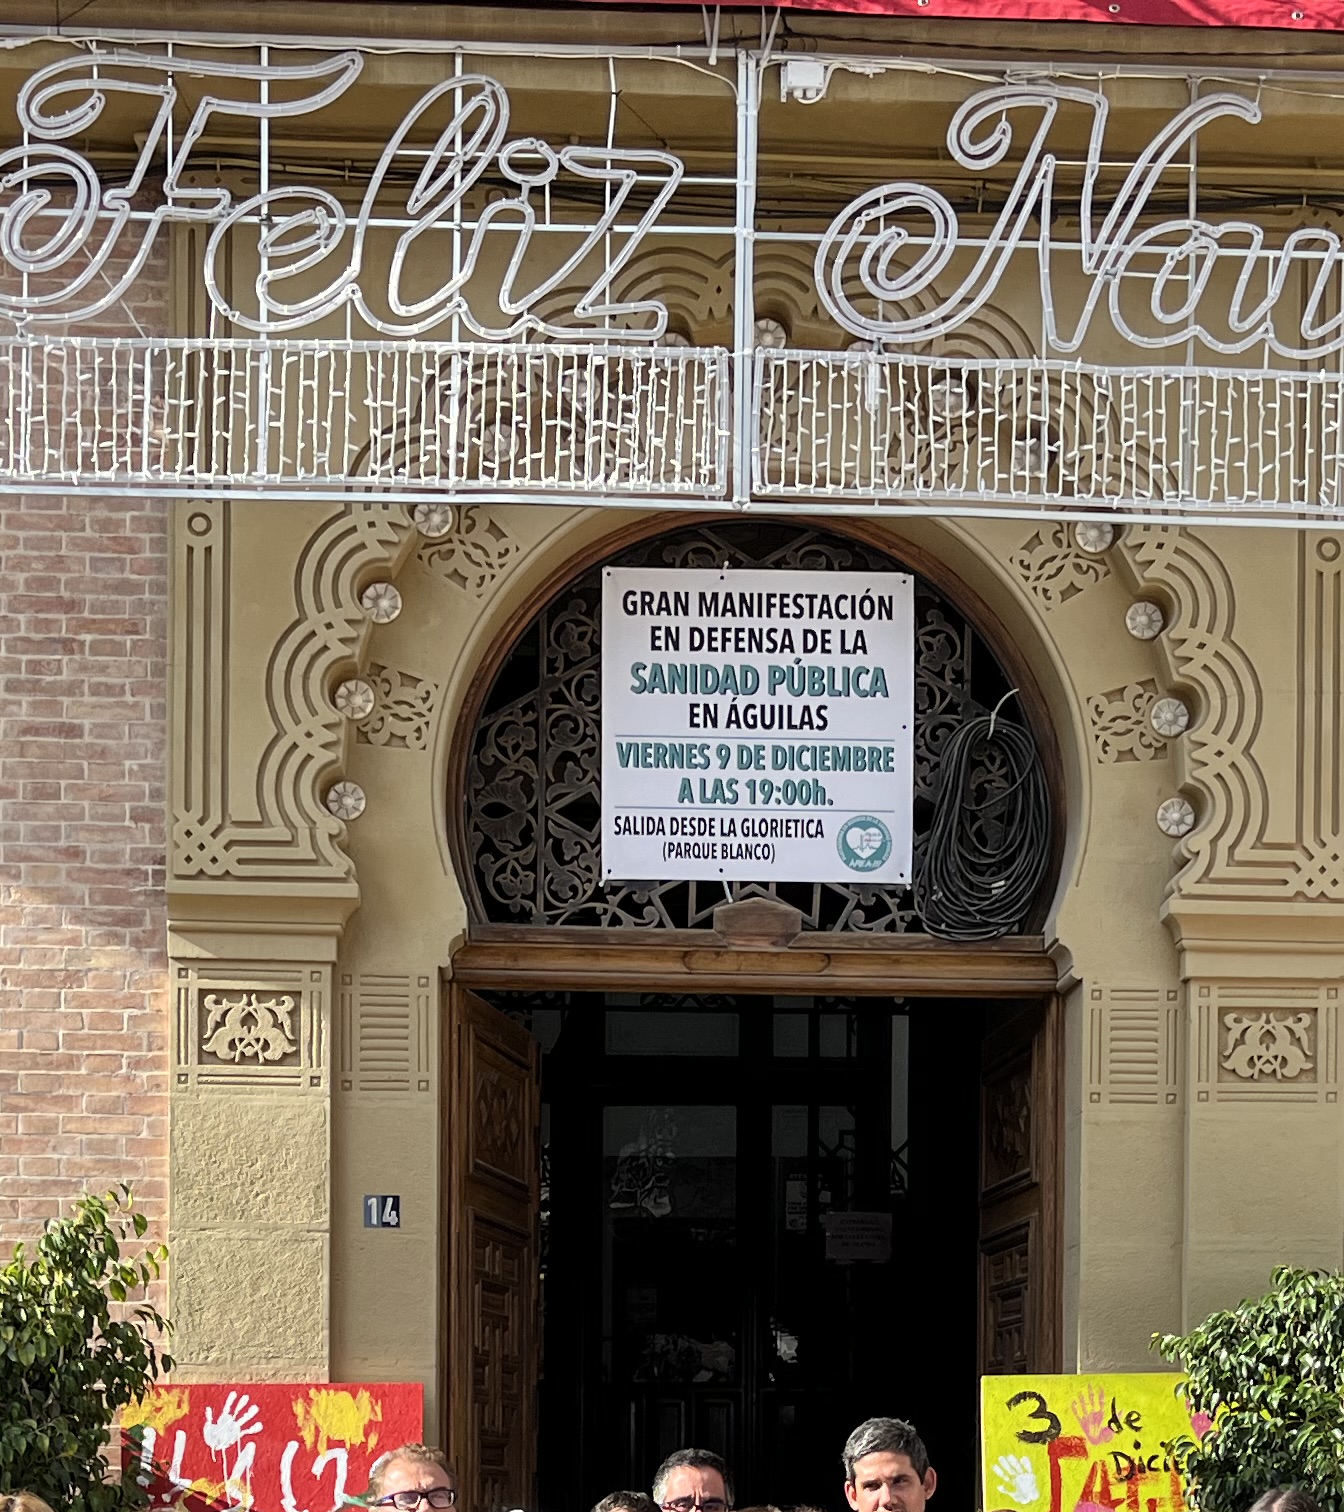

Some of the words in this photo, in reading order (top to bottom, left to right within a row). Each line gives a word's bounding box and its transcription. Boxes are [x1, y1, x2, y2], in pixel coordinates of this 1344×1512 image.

[622, 590, 690, 617] GRAN
[698, 588, 893, 620] MANIFESTACIÓN
[650, 626, 680, 651] EN
[689, 627, 795, 654] DEFENSA
[802, 629, 832, 654] DE
[840, 630, 868, 655] LA
[630, 662, 759, 696] SANIDAD
[767, 657, 889, 698] PÚBLICA
[689, 703, 718, 728] EN
[725, 697, 828, 731] ÁGUILAS
[615, 741, 711, 770] VIERNES
[716, 744, 731, 770] 9
[737, 744, 766, 771] DE
[771, 745, 895, 773] DICIEMBRE
[678, 778, 694, 804] A
[699, 778, 739, 805] LAS
[745, 778, 834, 806] 19:00h.
[614, 815, 666, 836] SALIDA
[669, 817, 716, 837] DESDE
[720, 818, 737, 838] LA
[741, 818, 824, 839] GLORIETICA
[662, 841, 718, 861] (PARQUE
[721, 842, 776, 864] BLANCO)
[368, 1197, 398, 1226] 14
[1006, 1390, 1061, 1444] 3
[1107, 1396, 1143, 1434] de
